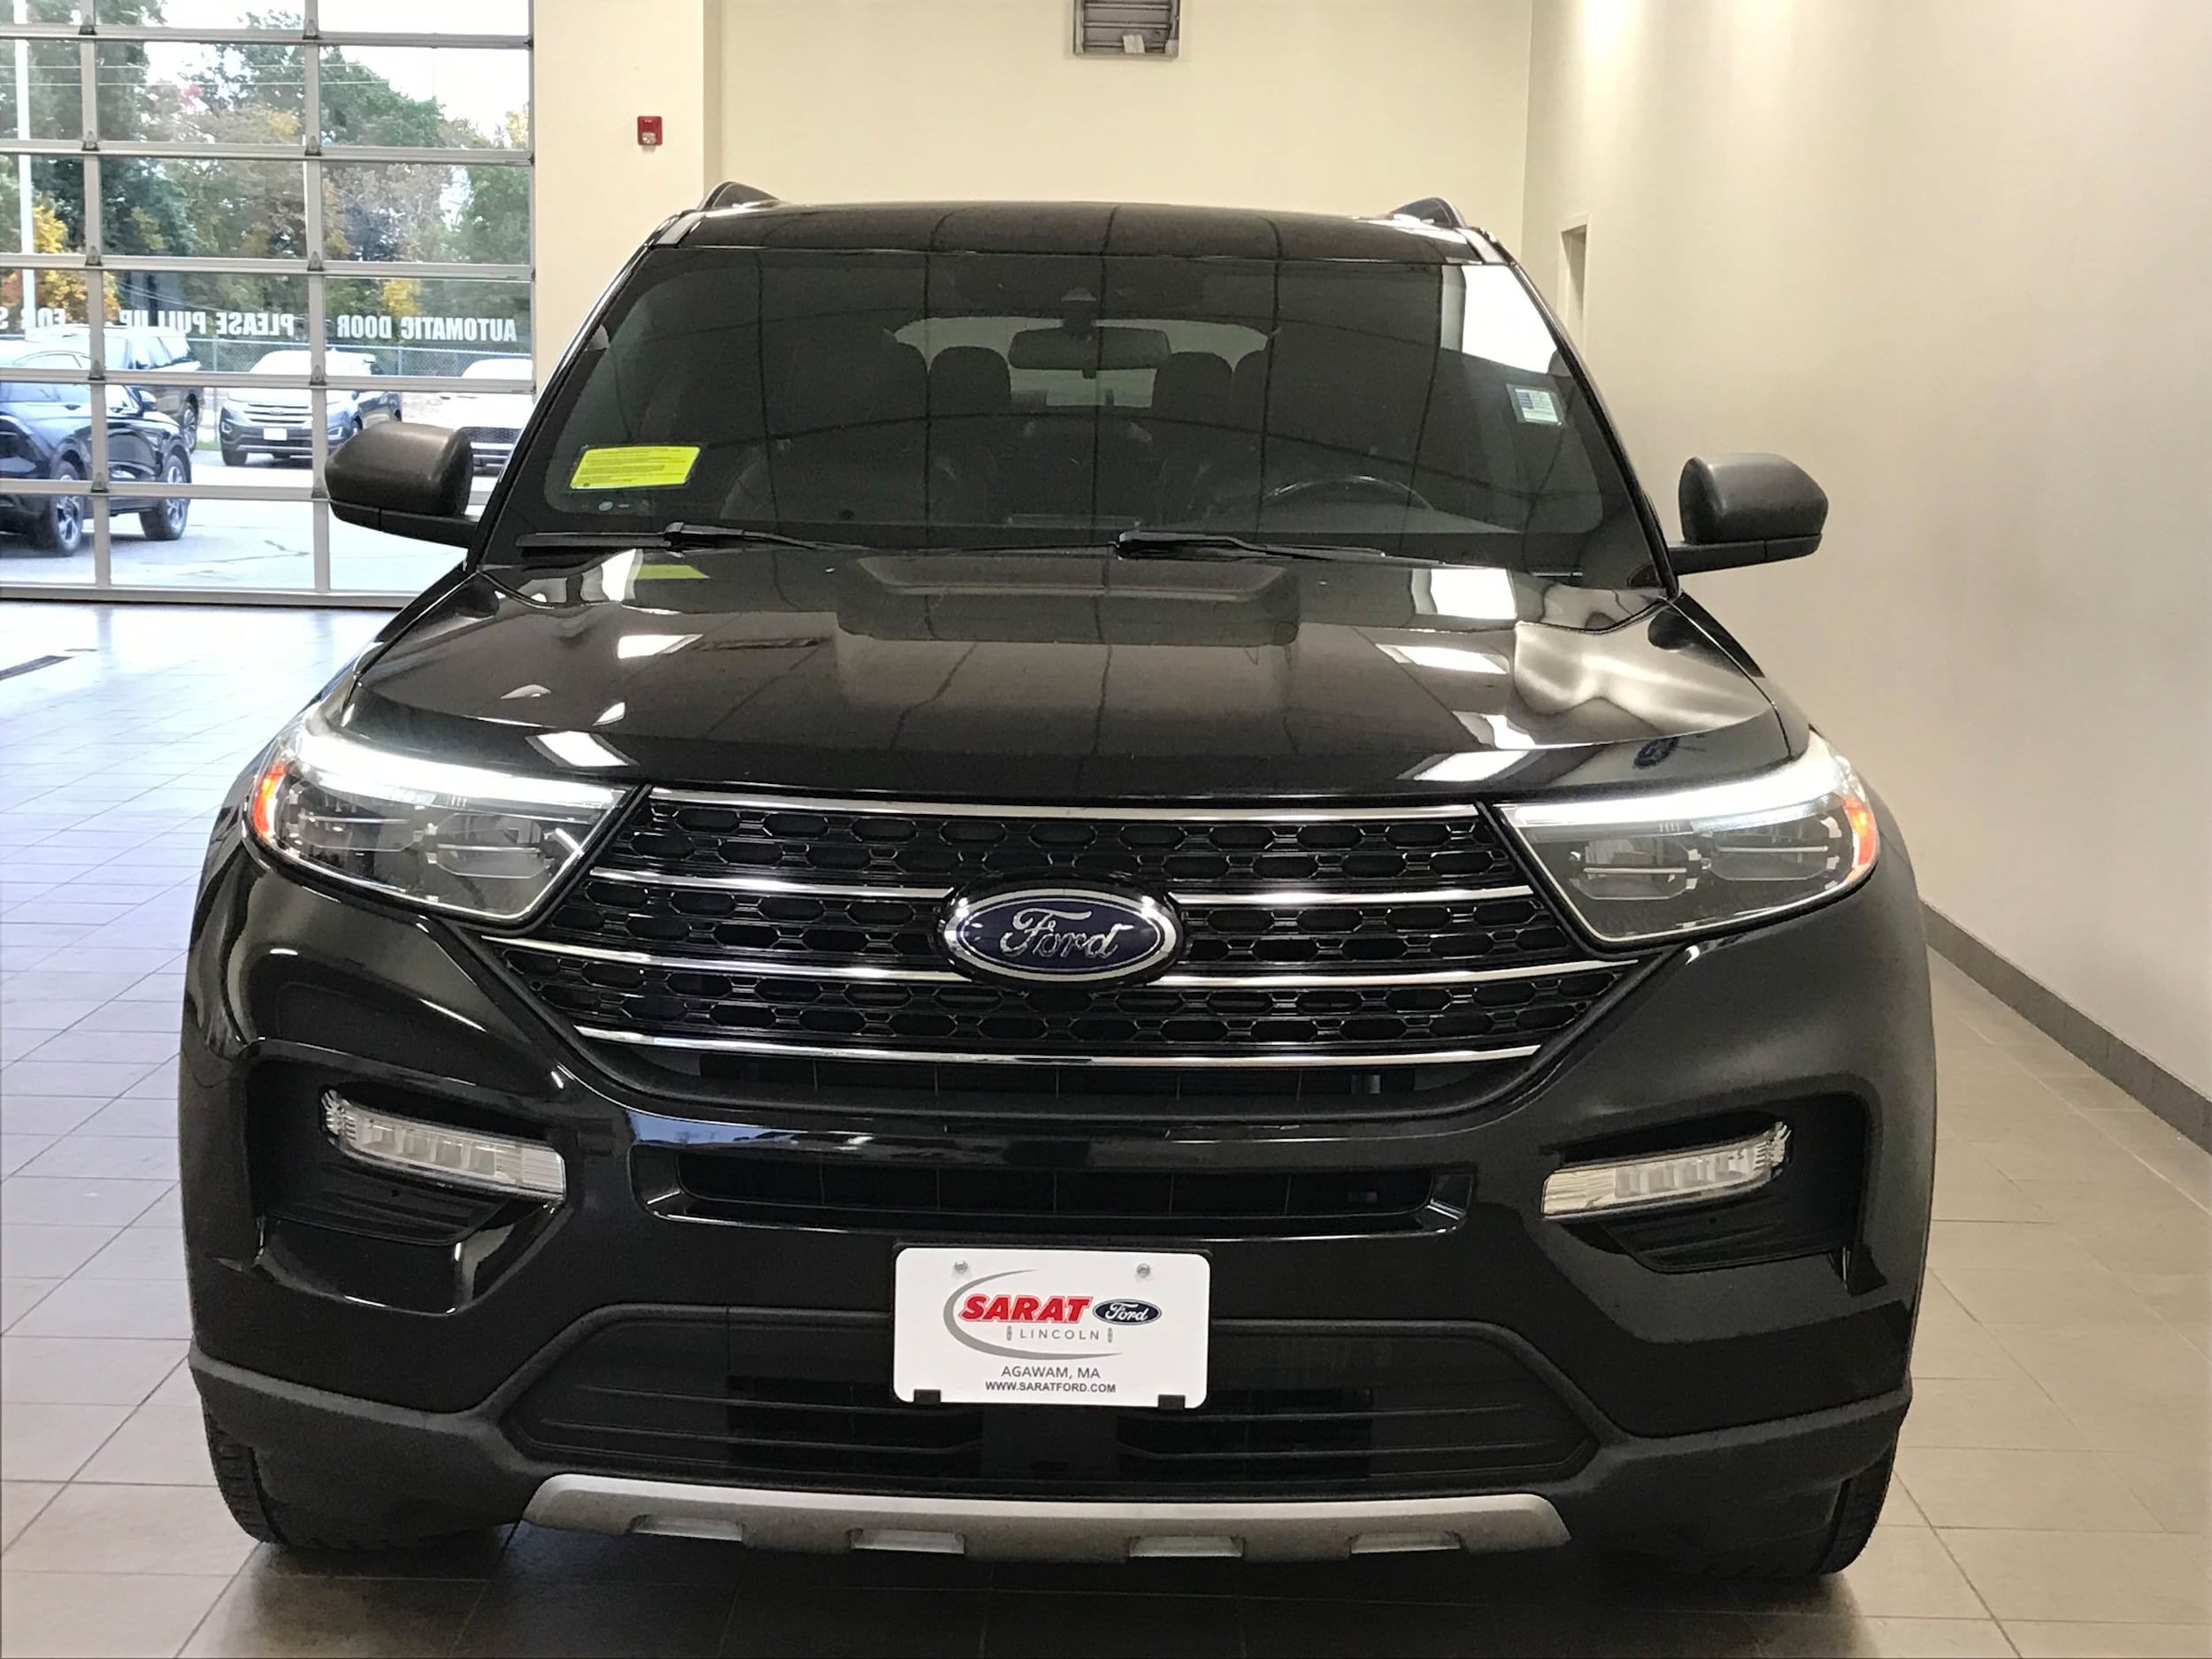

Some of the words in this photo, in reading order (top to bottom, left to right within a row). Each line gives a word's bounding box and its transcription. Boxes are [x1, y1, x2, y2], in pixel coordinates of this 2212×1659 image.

[999, 907, 1135, 959] Ford
[958, 1293, 1094, 1325] SARAT
[1105, 1301, 1151, 1323] Ford
[1019, 1329, 1100, 1340] LINCOLN
[1001, 1365, 1073, 1379] AGAWAM,
[1077, 1367, 1101, 1379] MA
[985, 1380, 1117, 1394] WWW.SARATFORD.COM
